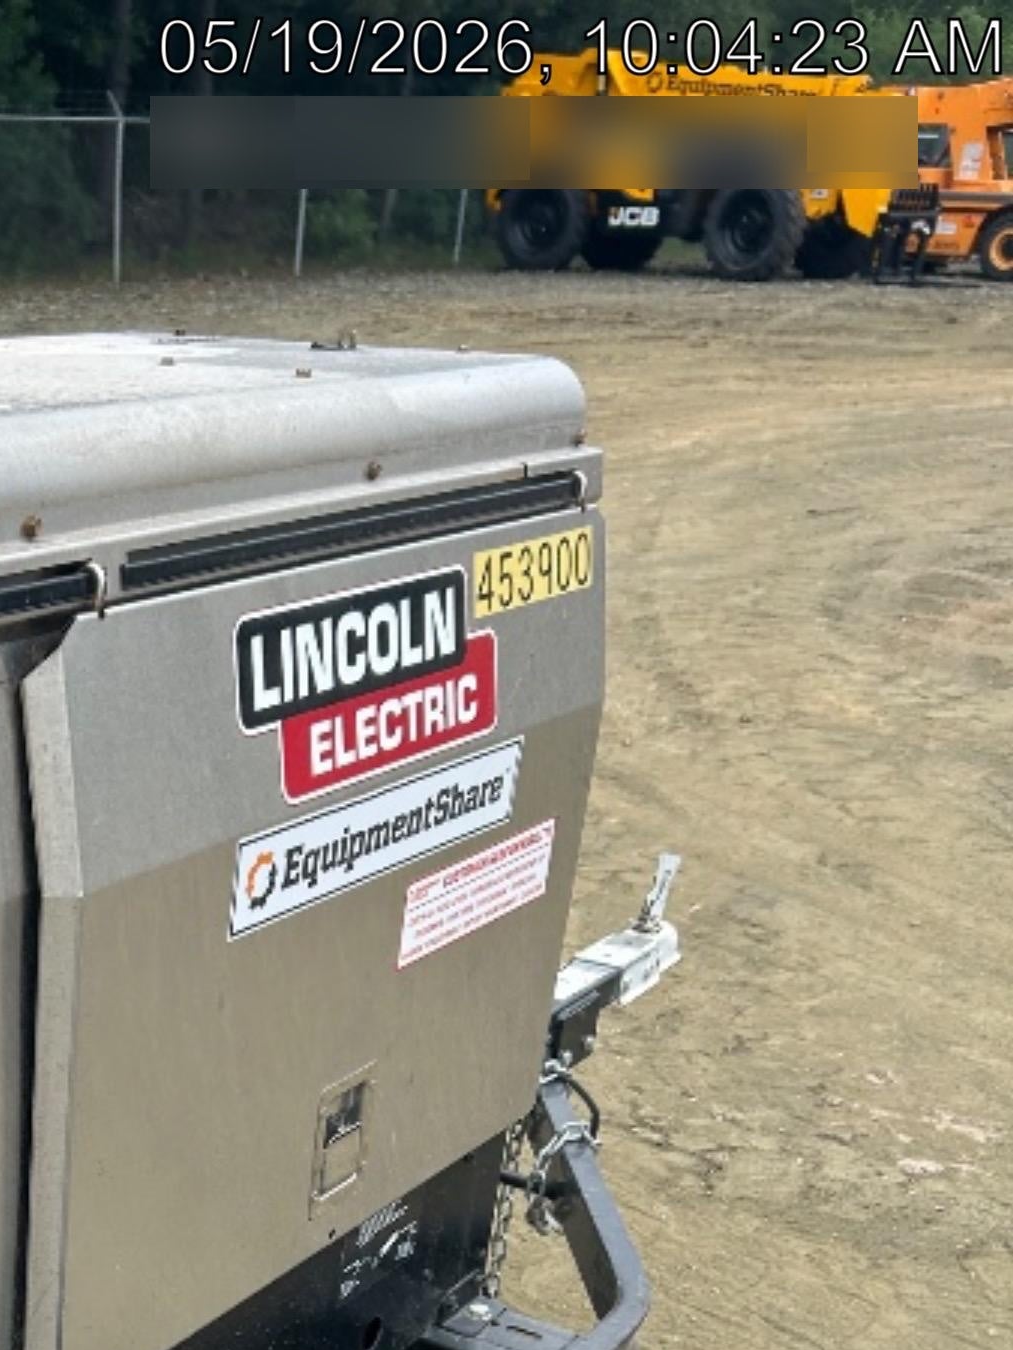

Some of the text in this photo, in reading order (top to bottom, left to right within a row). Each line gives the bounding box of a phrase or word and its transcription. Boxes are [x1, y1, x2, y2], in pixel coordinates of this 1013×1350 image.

[608, 205, 660, 228] JCB
[477, 532, 591, 610] 453900
[251, 584, 457, 711] LINCOLN
[310, 674, 478, 776] ELECTRIC
[281, 774, 505, 887] EquipmentShare
